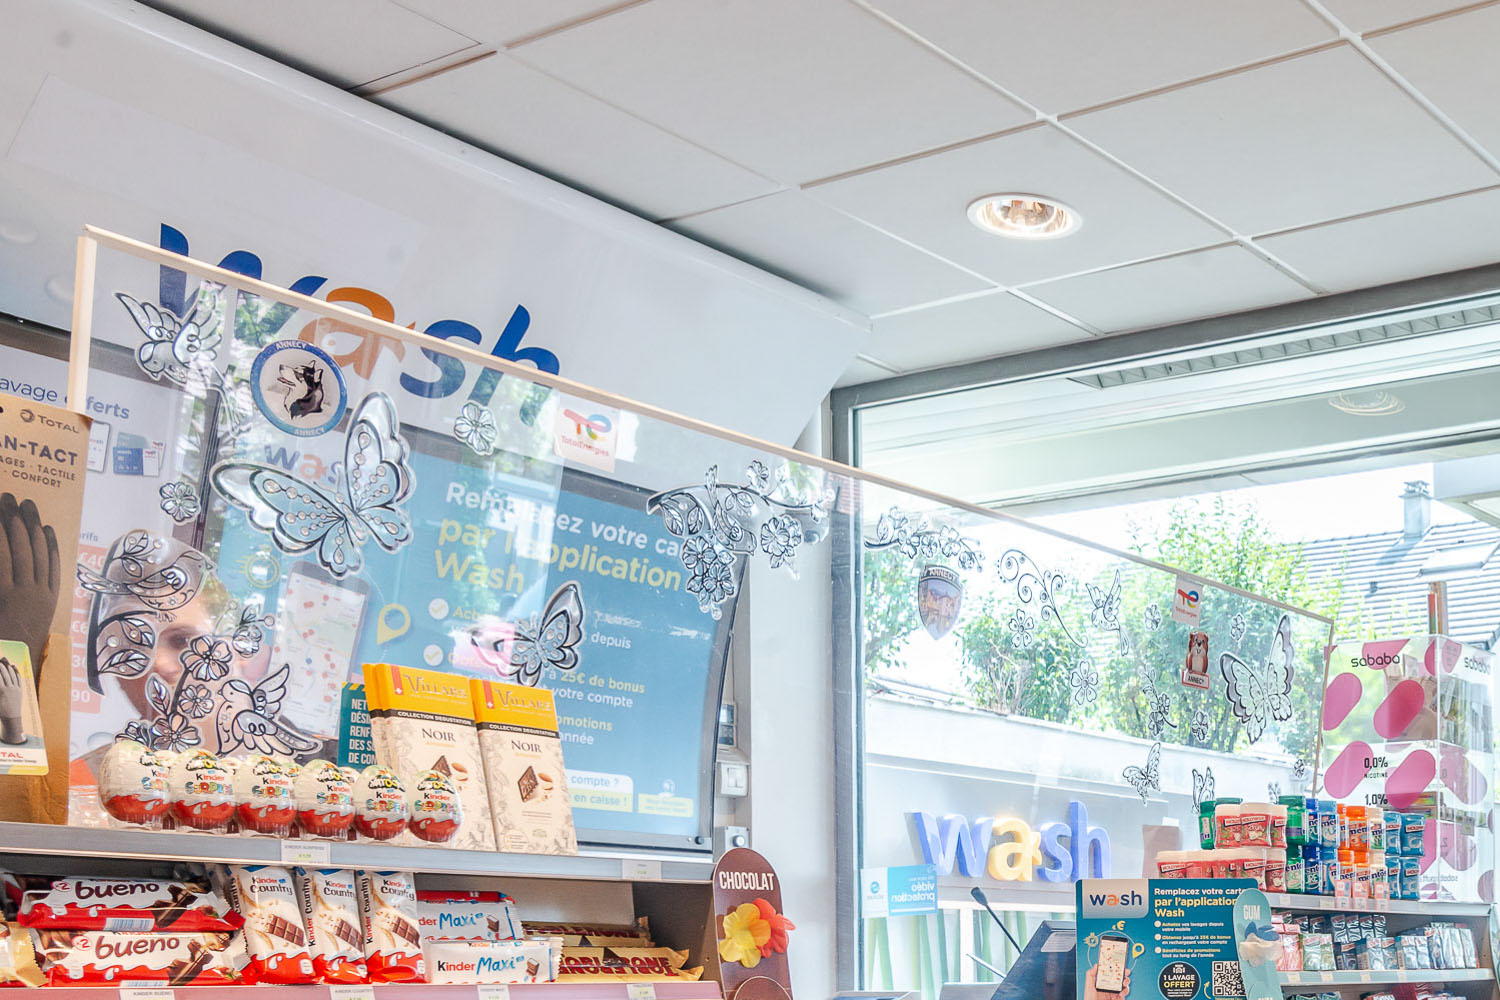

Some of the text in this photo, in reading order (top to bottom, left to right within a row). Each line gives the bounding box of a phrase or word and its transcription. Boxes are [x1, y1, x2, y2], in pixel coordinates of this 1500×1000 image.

[37, 414, 81, 434] TOTAL
[12, 469, 62, 489] CONFORT
[37, 464, 77, 482] TACTILE
[590, 519, 648, 550] votre
[434, 549, 525, 594] Wash
[590, 631, 633, 651] depuis
[1350, 653, 1401, 668] sababa
[560, 670, 586, 686] 25€
[588, 675, 606, 687] de
[608, 677, 646, 695] bonus
[587, 690, 634, 710] compte
[397, 711, 436, 721] COLLECTION
[421, 728, 456, 743] NOIR
[511, 740, 542, 754] NOIR
[1363, 756, 1389, 770] 0,0%
[591, 796, 620, 808] caisse
[910, 799, 1112, 883] wash
[75, 878, 160, 900] bueno
[249, 882, 294, 898] Country
[1088, 889, 1143, 908] wash
[1154, 888, 1200, 897] Remplacez
[1154, 898, 1173, 908] par
[1154, 907, 1185, 918] Wash
[1243, 904, 1261, 921] GUM
[438, 911, 476, 932] Maxi
[94, 935, 181, 961] bueno
[437, 956, 516, 977] Kinder Maxi
